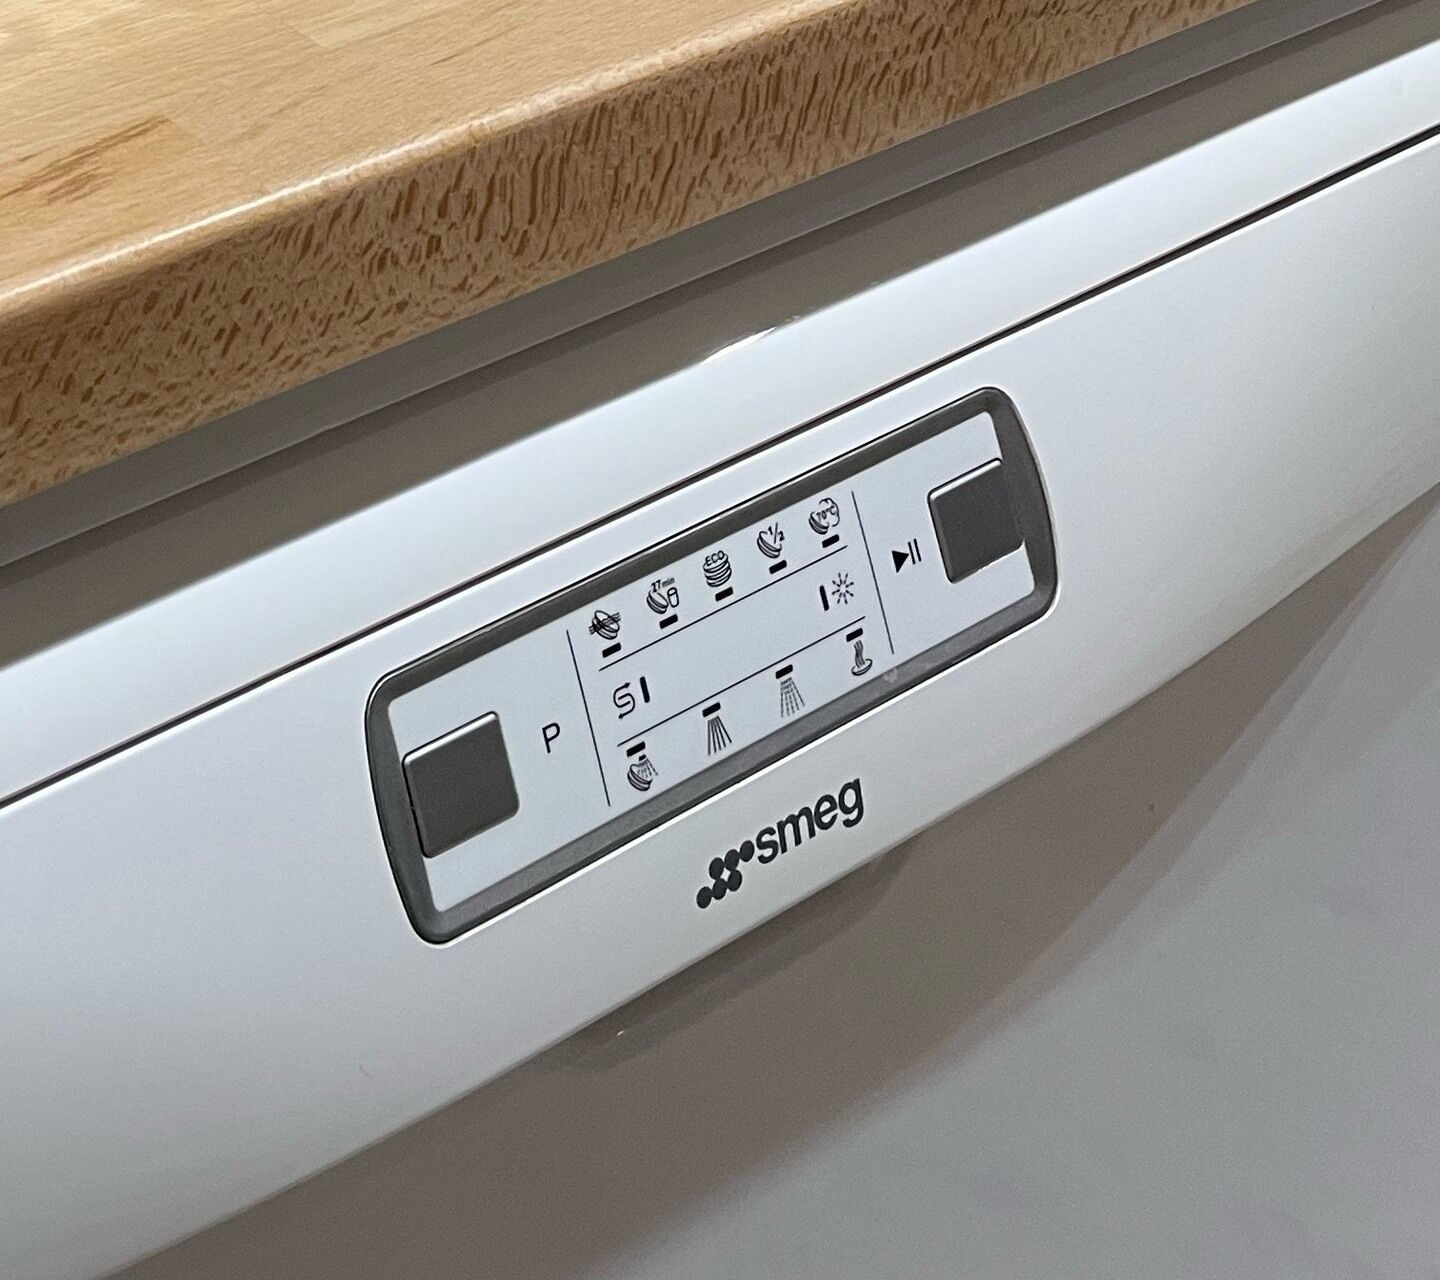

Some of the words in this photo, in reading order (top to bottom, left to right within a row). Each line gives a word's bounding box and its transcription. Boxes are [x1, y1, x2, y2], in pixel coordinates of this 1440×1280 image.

[705, 550, 725, 567] ECO
[541, 722, 561, 754] P
[754, 777, 865, 864] smeg
